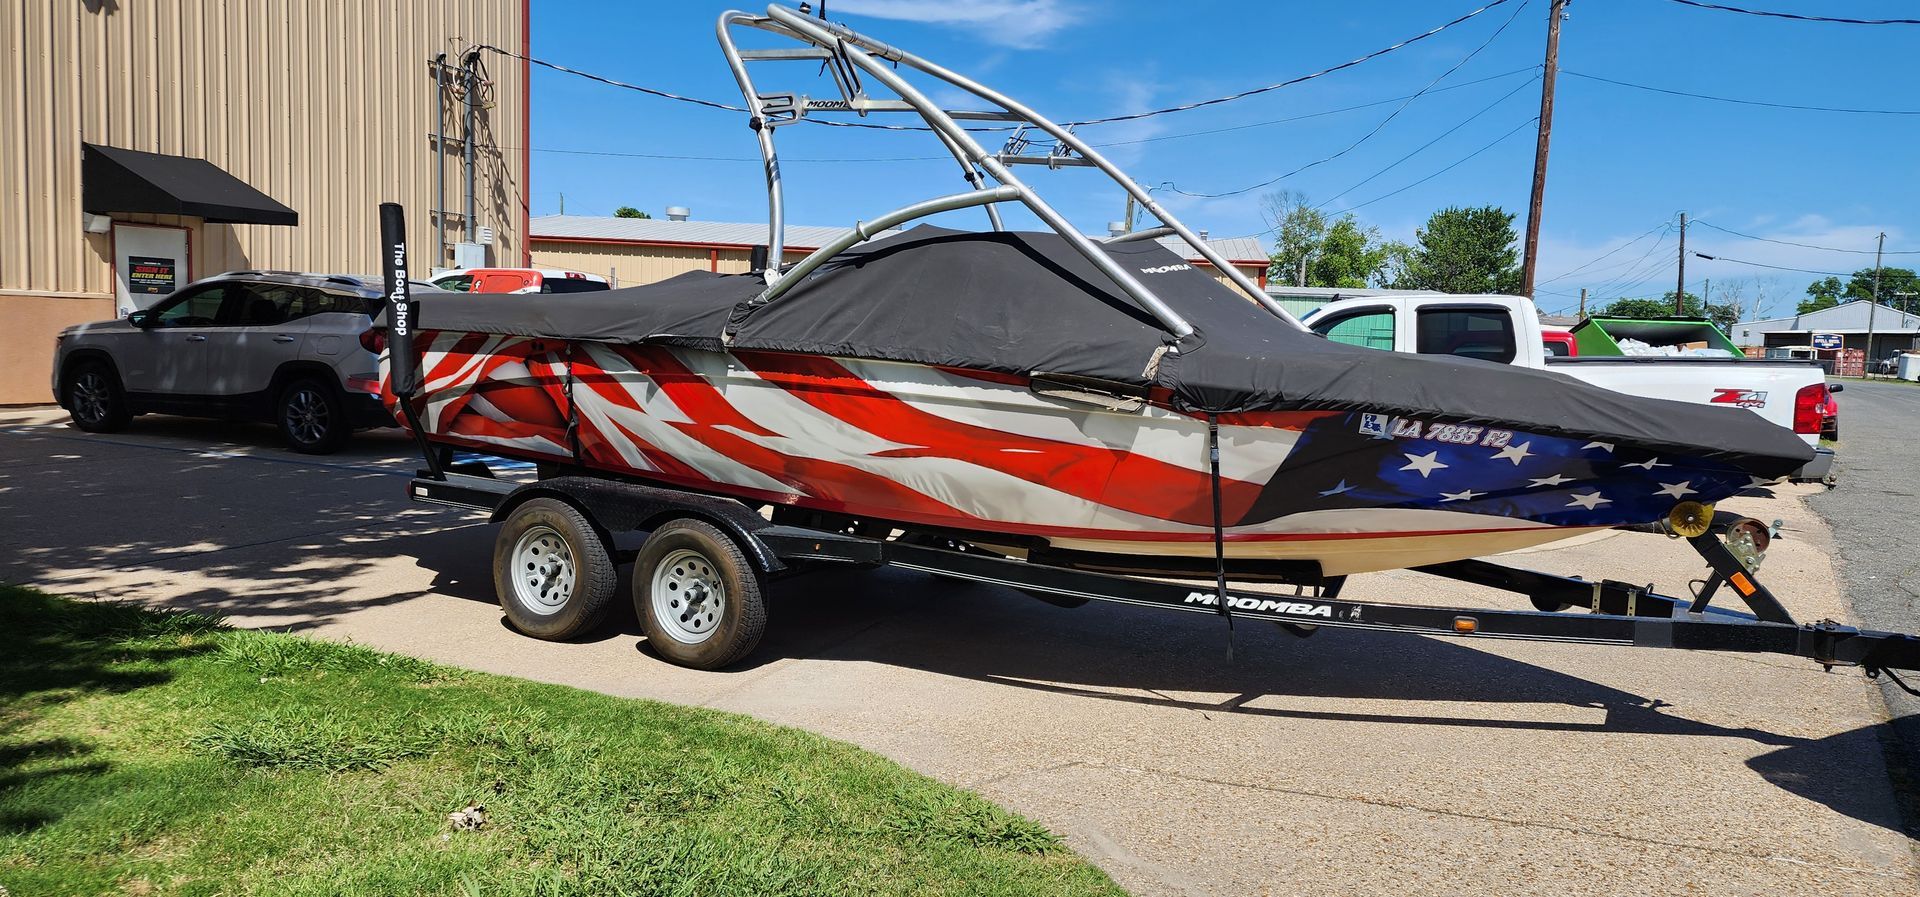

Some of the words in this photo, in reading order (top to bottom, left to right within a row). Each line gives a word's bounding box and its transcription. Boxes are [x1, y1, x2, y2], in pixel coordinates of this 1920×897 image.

[807, 100, 850, 108] MOOM
[394, 242, 405, 266] The
[390, 269, 406, 302] Boat
[395, 302, 408, 336] Shop
[1392, 418, 1423, 438] LA
[1424, 422, 1483, 444] 7835
[1479, 428, 1513, 448] F2
[1184, 591, 1332, 617] MOOMBA
